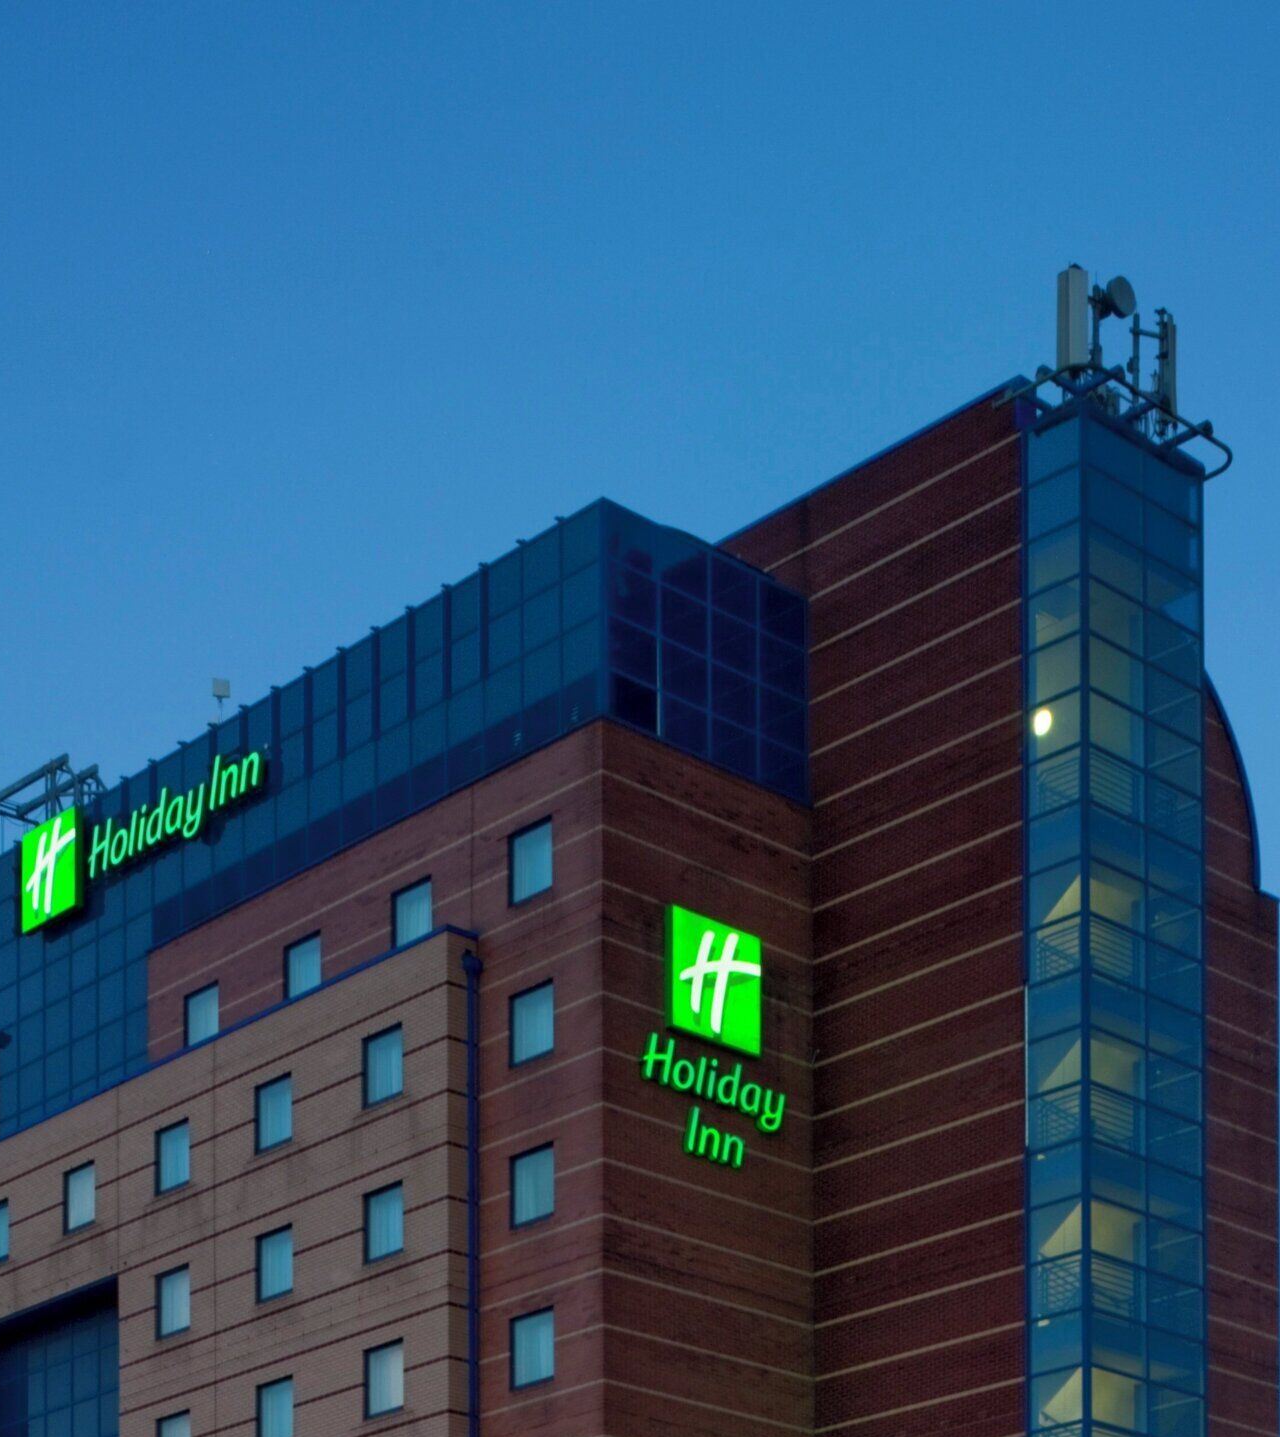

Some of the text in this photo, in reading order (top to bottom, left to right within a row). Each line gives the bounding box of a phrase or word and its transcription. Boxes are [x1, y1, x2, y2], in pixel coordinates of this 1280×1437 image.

[87, 751, 261, 879] Holiday Inn
[642, 1031, 786, 1132] Holiday
[684, 1105, 746, 1168] Inn
